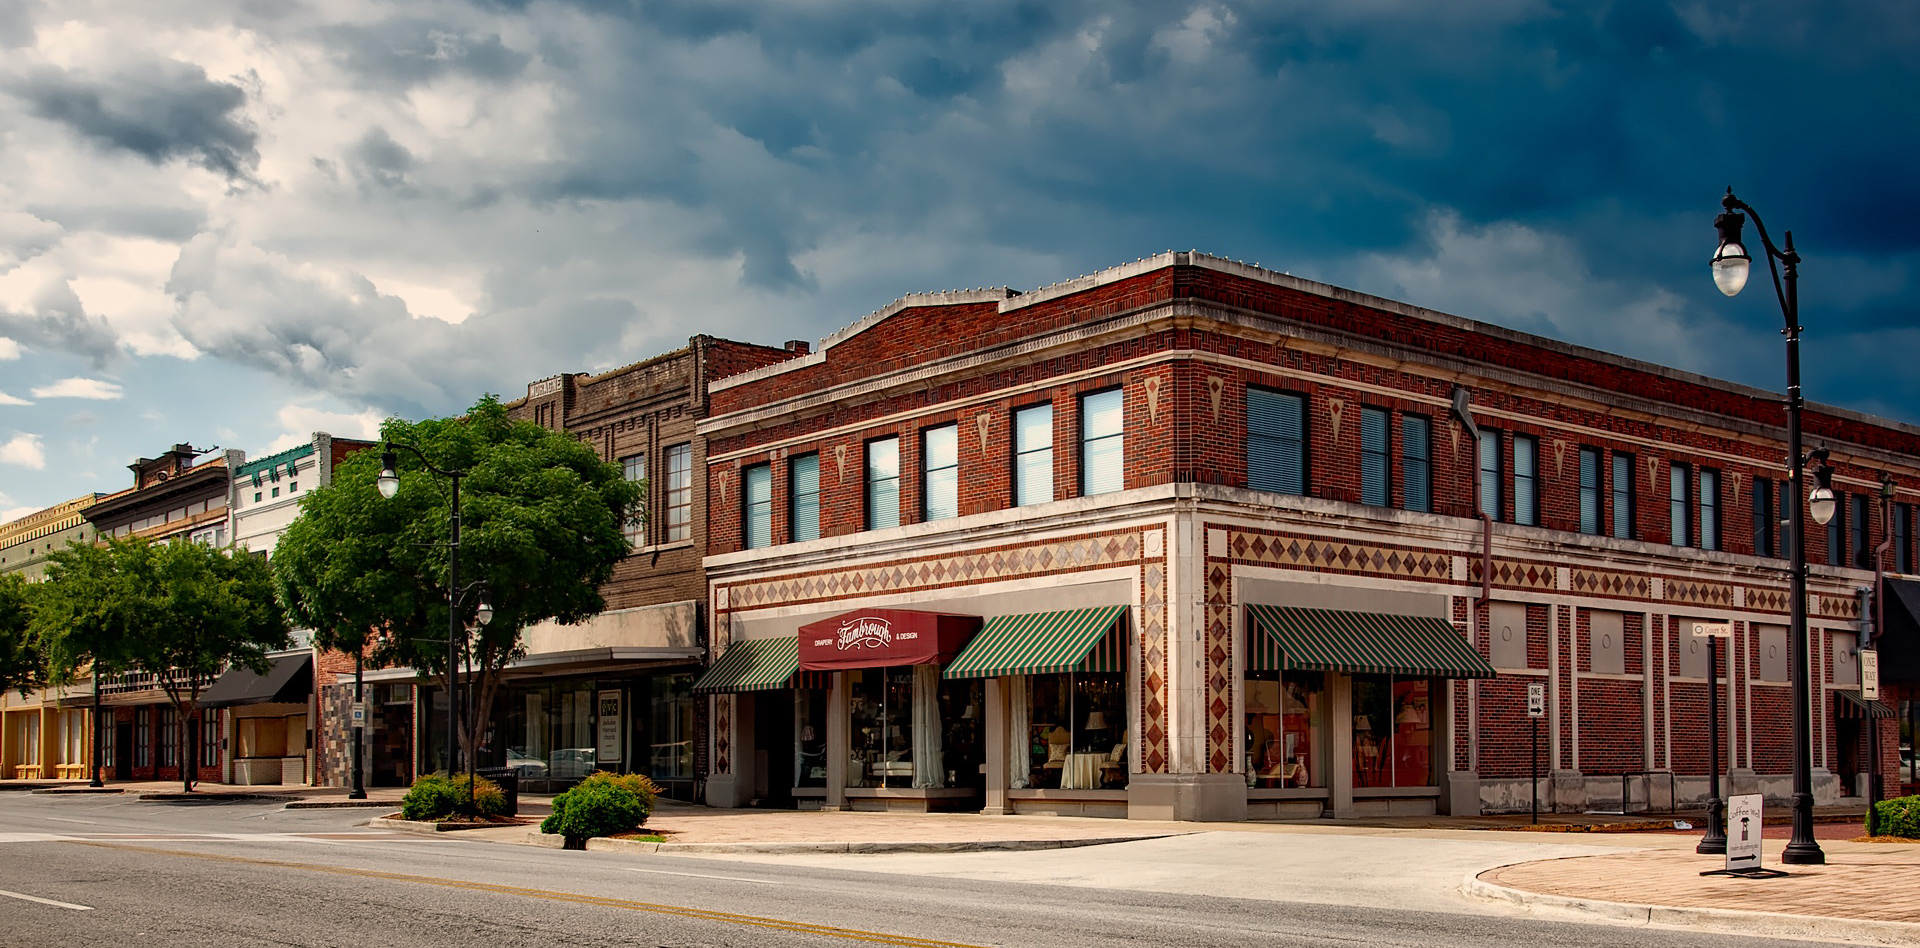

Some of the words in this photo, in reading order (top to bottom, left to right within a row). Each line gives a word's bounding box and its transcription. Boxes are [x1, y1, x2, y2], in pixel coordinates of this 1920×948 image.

[814, 638, 833, 647] DRAPERY
[837, 617, 892, 650] Fambrough
[896, 632, 900, 640] &
[900, 632, 918, 640] DESIGN
[1705, 626, 1719, 634] Court
[1864, 657, 1876, 667] ONE
[1864, 671, 1876, 681] WAY
[1531, 687, 1541, 695] ONE
[1729, 806, 1749, 820] Coffee
